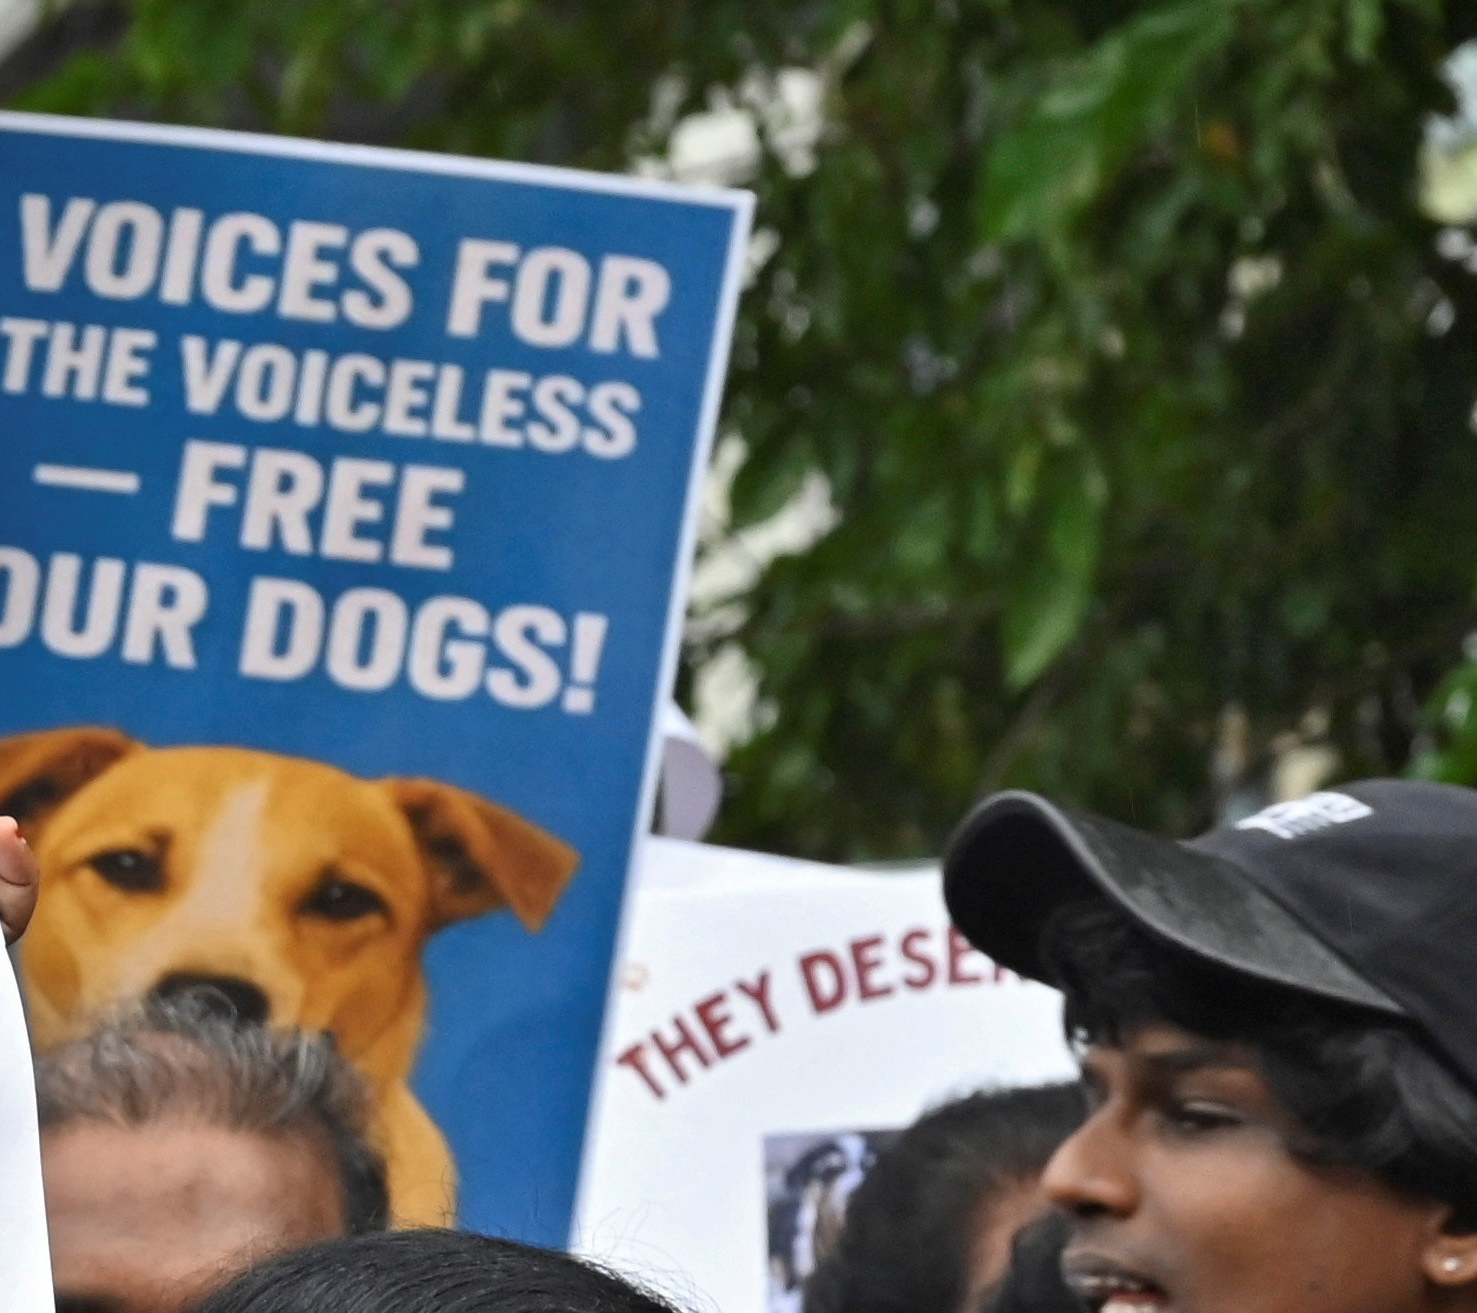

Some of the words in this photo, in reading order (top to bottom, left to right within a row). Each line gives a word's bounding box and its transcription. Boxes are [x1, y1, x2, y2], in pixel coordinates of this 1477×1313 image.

[20, 193, 421, 330] VOICES
[447, 238, 672, 358] FOR
[0, 317, 157, 407] THE
[180, 335, 644, 459] VOICELESS
[172, 438, 467, 571] FREE
[240, 575, 609, 717] DOGS!
[616, 967, 780, 1101] THEY
